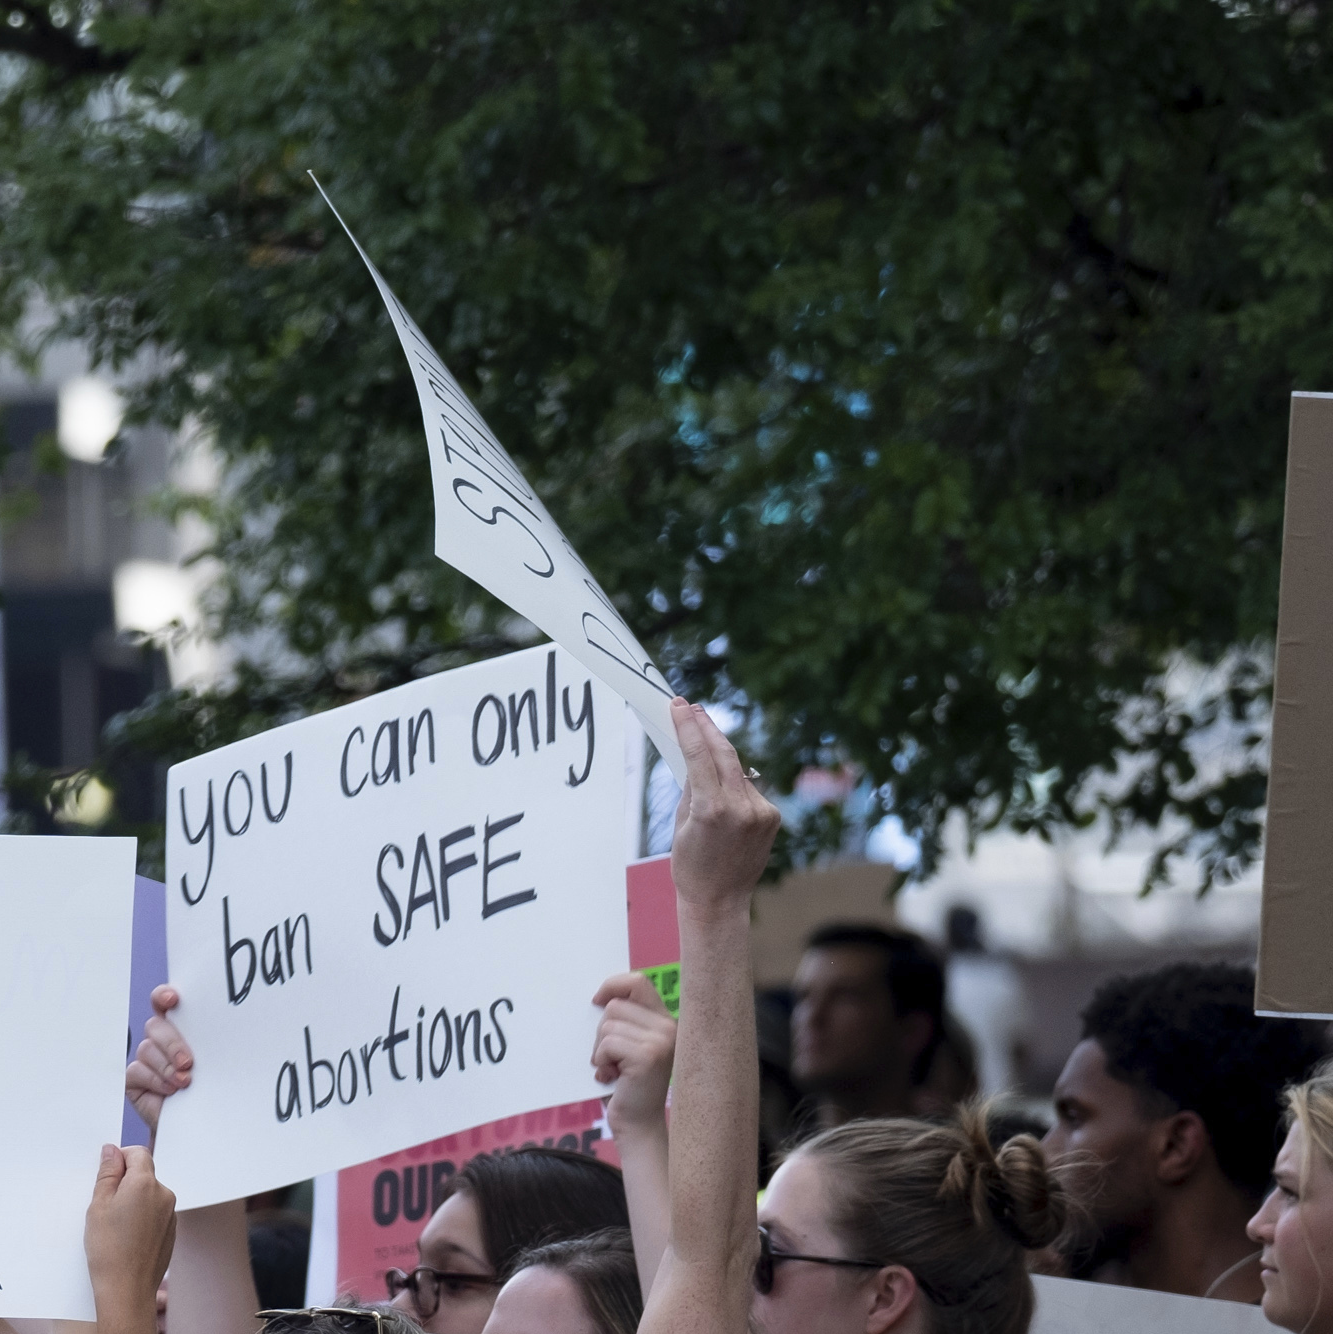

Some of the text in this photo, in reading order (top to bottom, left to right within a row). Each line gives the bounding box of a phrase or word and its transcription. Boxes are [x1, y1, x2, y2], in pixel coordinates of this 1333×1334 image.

[180, 650, 594, 906] you can only
[223, 813, 537, 1005] ban SAFE
[276, 986, 514, 1123] abortions
